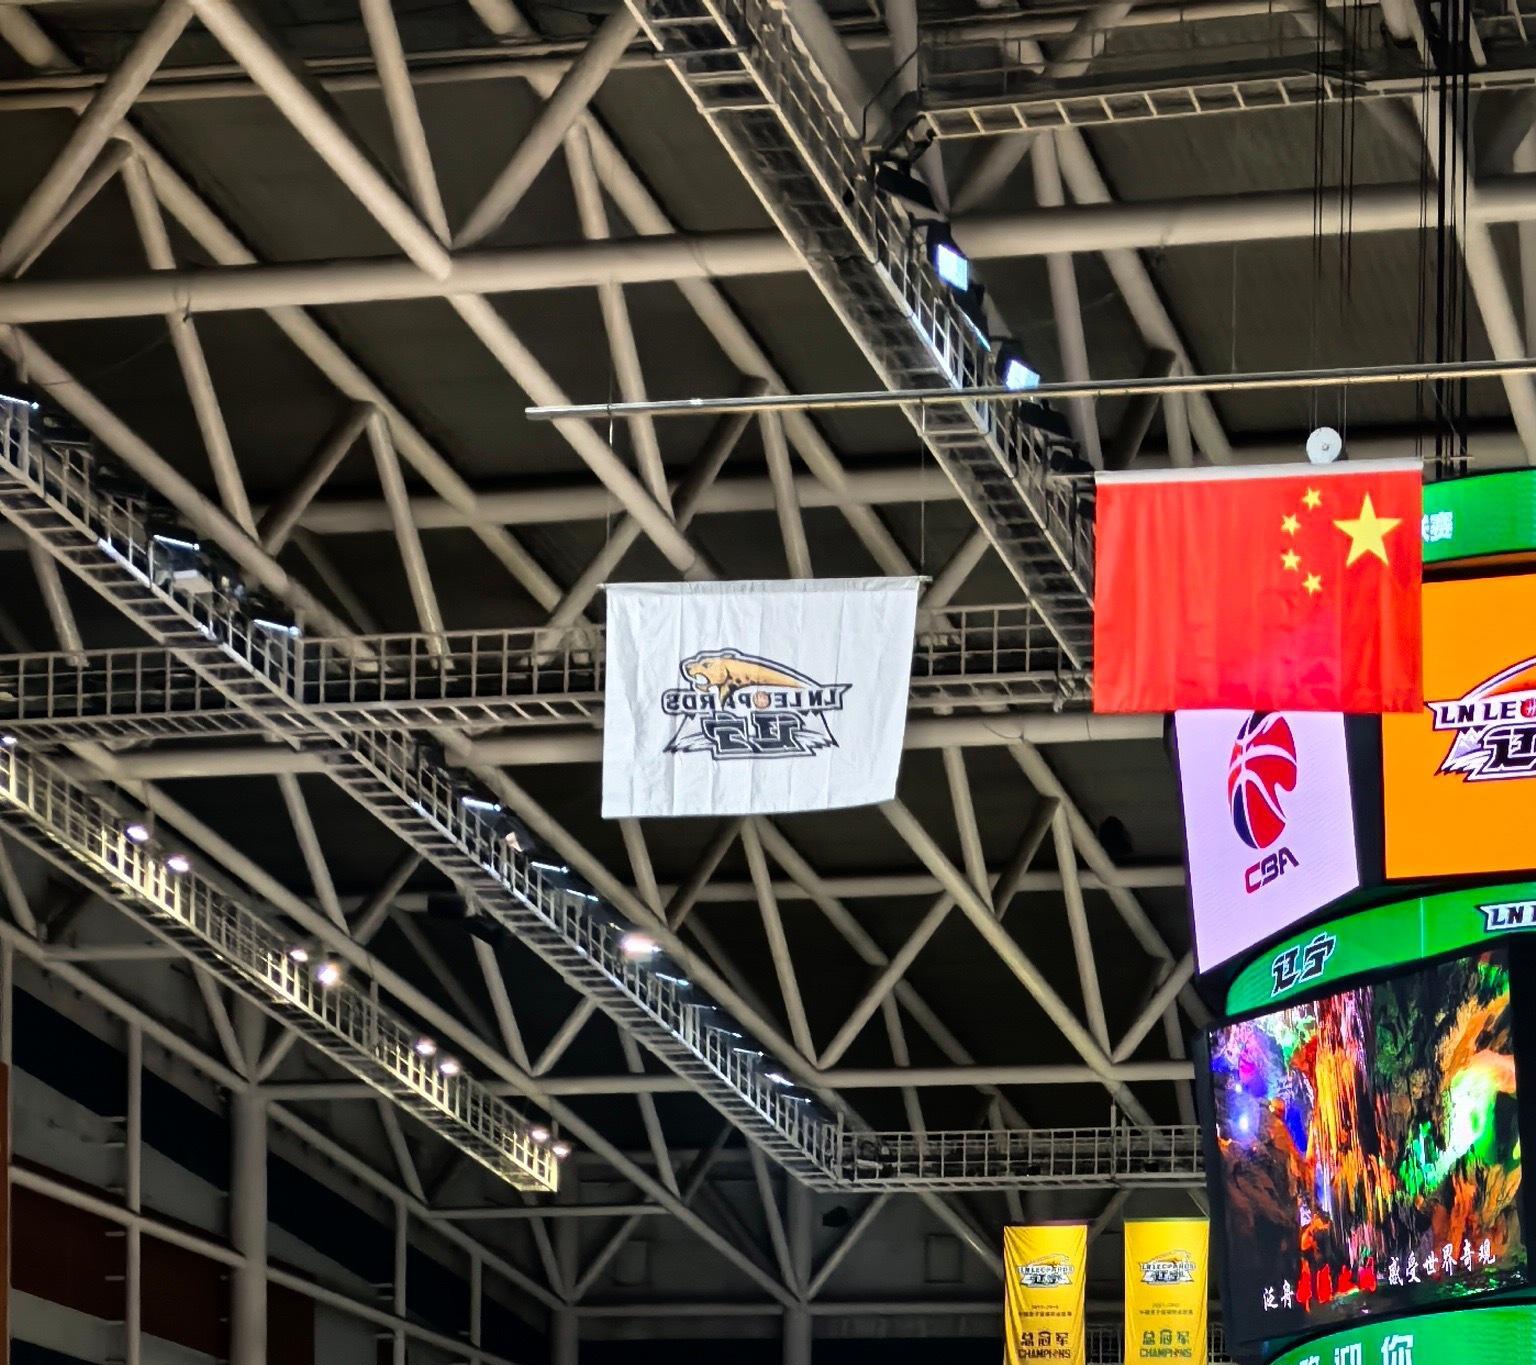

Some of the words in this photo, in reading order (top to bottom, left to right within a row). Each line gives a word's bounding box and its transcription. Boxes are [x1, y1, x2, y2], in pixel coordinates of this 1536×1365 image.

[1244, 847, 1300, 894] CBA
[1489, 904, 1525, 927] LN
[1271, 932, 1336, 997] 辽宁
